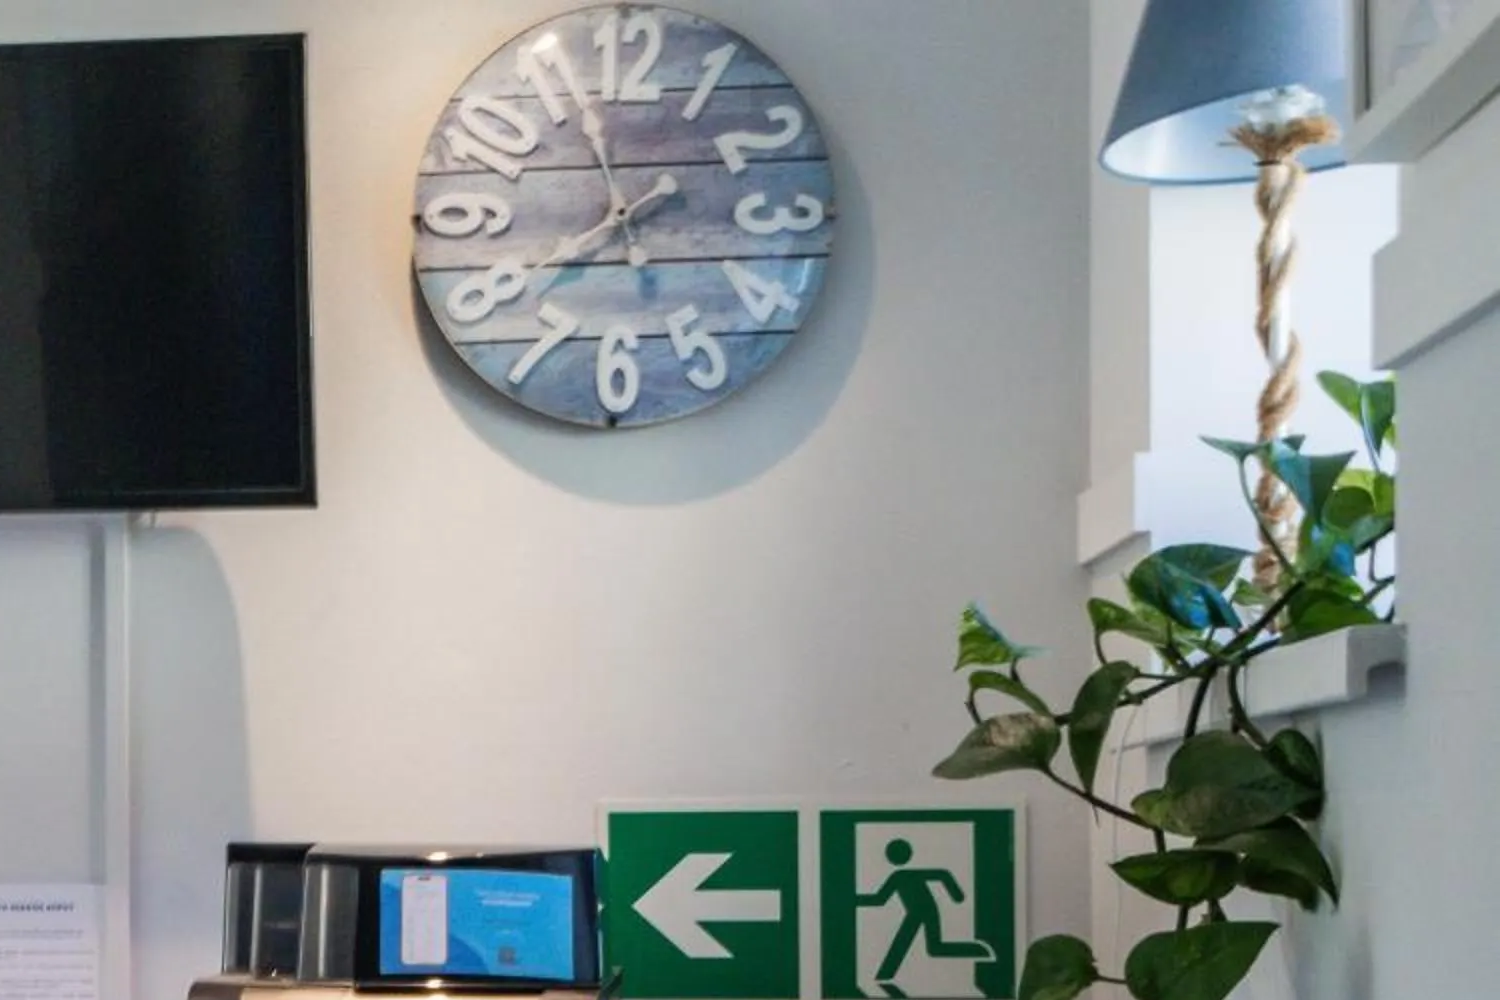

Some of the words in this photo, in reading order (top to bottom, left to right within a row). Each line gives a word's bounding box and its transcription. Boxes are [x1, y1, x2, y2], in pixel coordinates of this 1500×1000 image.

[517, 32, 589, 123] 11
[594, 15, 662, 101] 12
[682, 42, 738, 121] 1
[445, 95, 538, 181] 10
[713, 105, 802, 175] 2
[424, 193, 511, 236] 9
[734, 193, 823, 234] 3
[447, 257, 526, 323] 8
[721, 259, 799, 322] 4
[508, 302, 580, 384] 7
[597, 325, 639, 413] 6
[665, 303, 726, 391] 5
